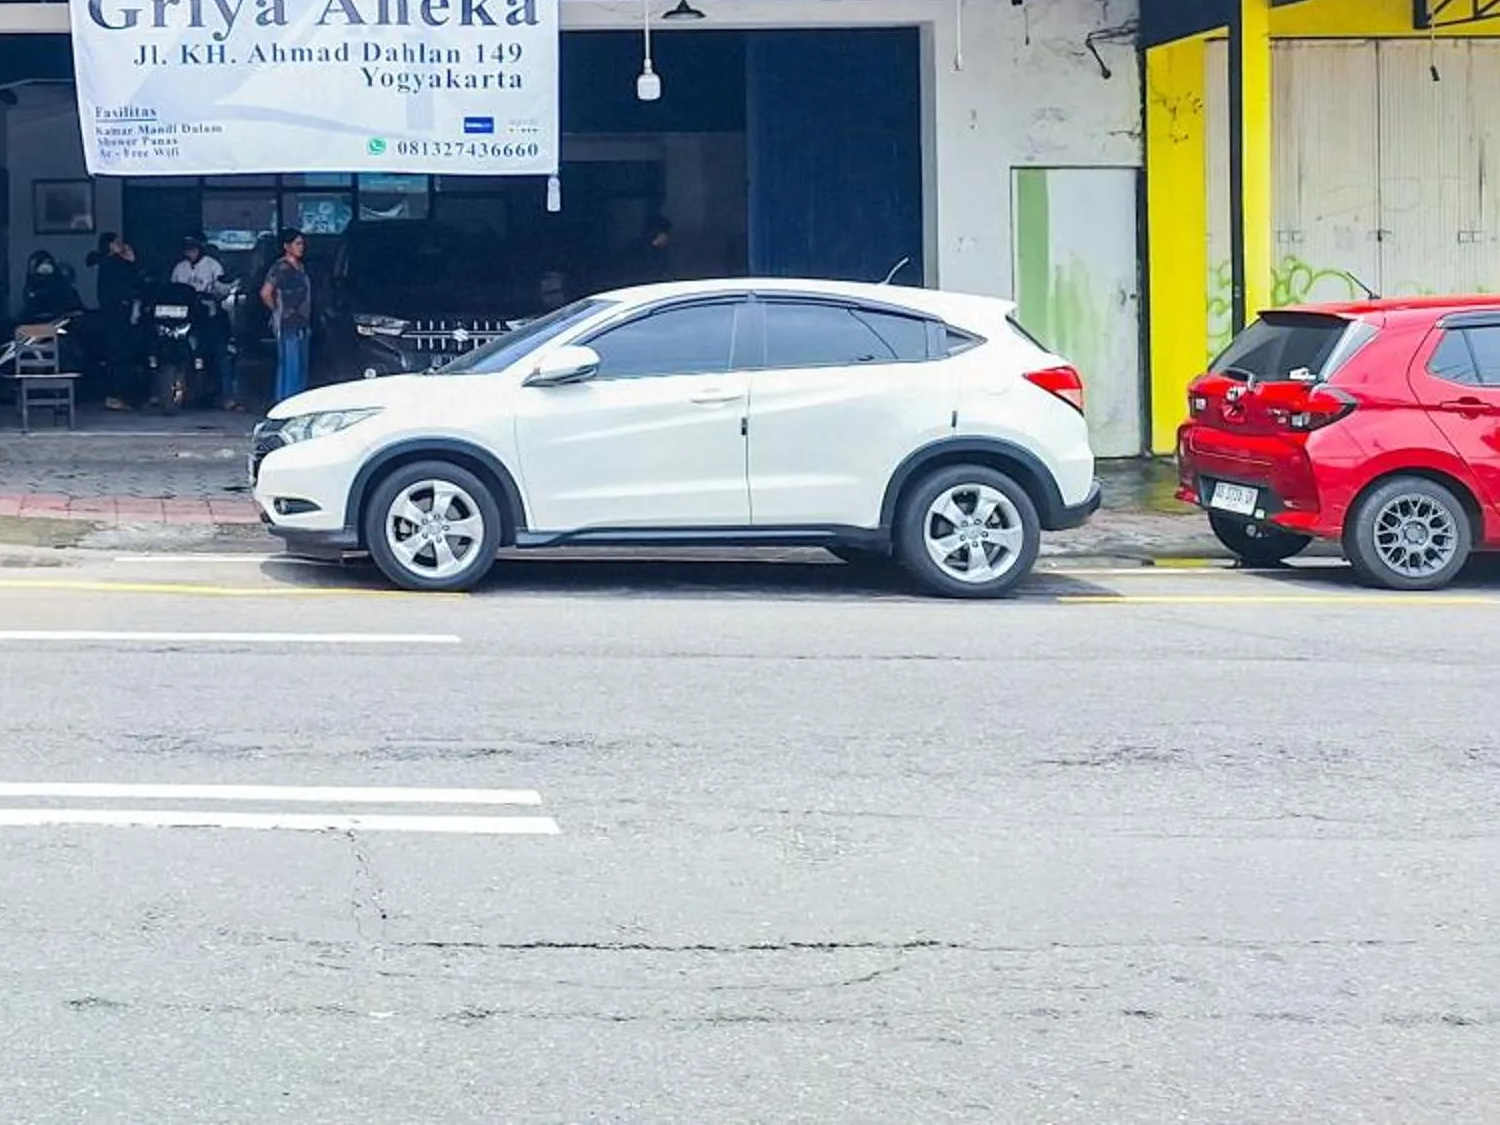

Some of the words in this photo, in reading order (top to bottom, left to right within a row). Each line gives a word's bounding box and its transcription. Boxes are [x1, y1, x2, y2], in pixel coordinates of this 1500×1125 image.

[134, 44, 167, 67] Jl.
[181, 44, 236, 65] KH.
[248, 43, 349, 64] Ahmad
[363, 42, 461, 64] Dahlan
[476, 42, 523, 64] 149
[361, 67, 523, 94] Yogyakarta
[95, 106, 158, 119] Fasilitas
[96, 125, 134, 136] Kamar
[138, 124, 177, 135] Mandi
[182, 123, 223, 134] Dalam
[97, 137, 137, 147] Shower
[142, 136, 178, 146] Panas
[397, 140, 539, 158] 081327436660
